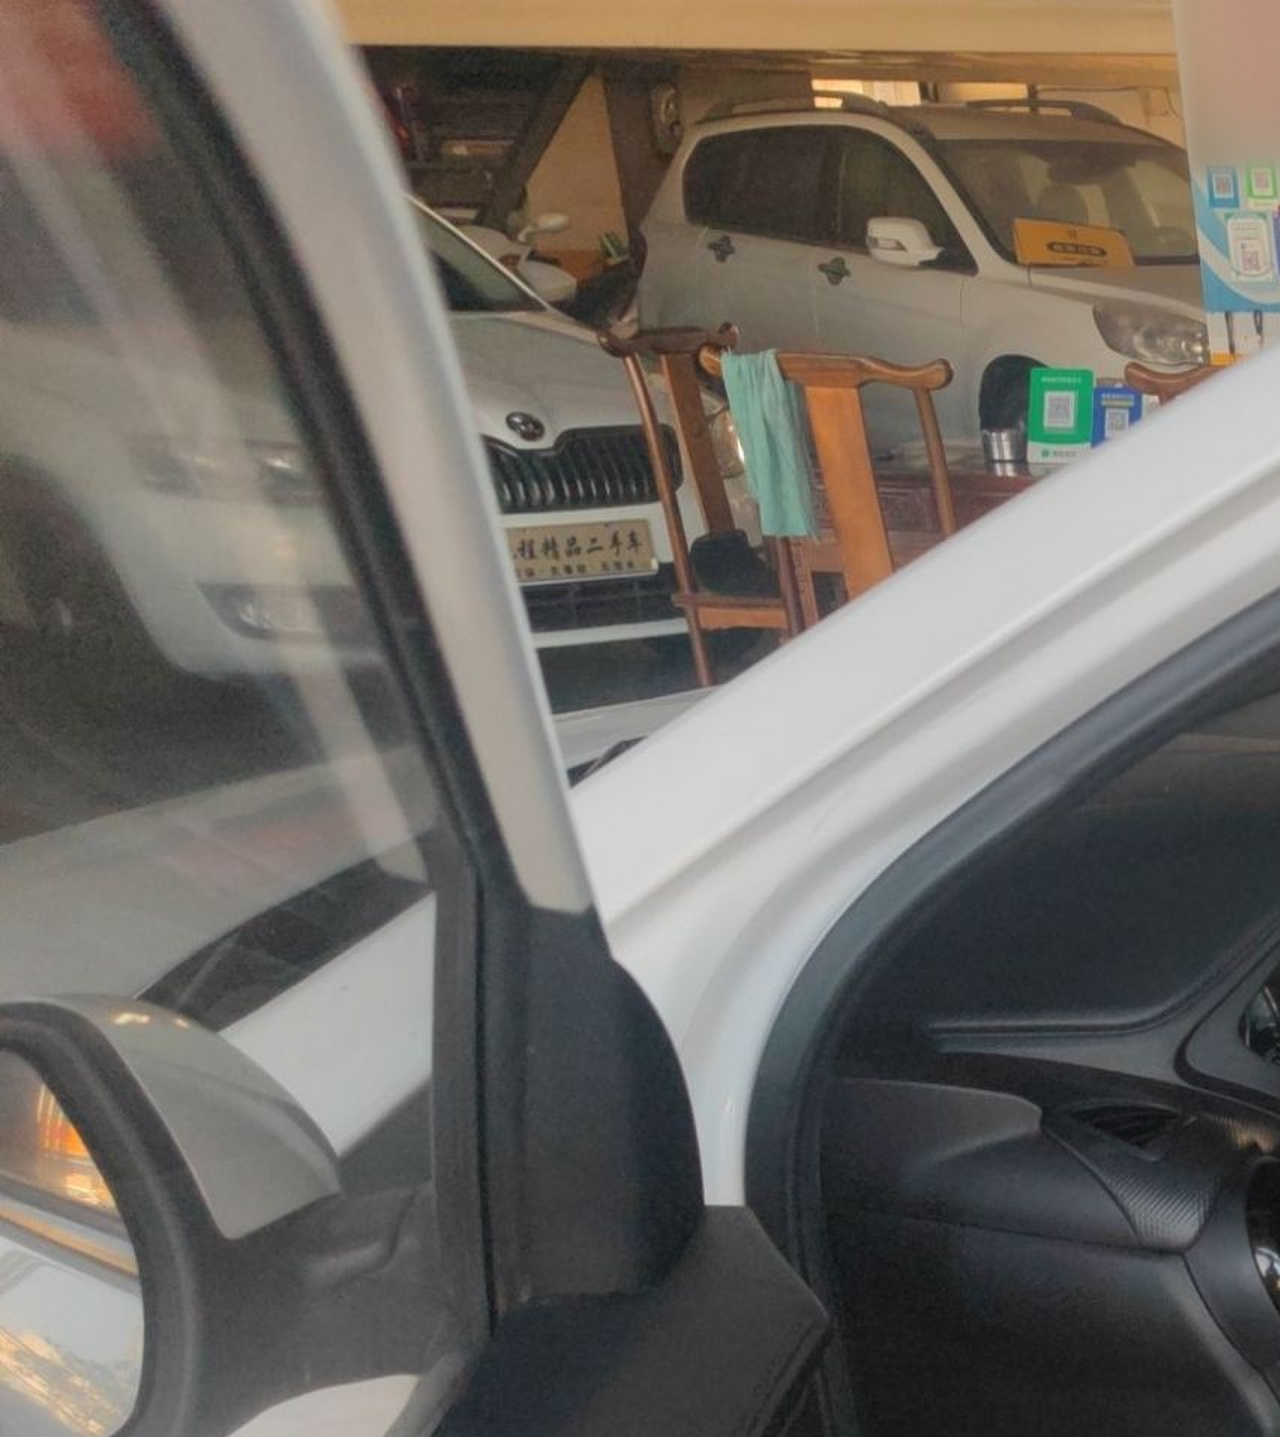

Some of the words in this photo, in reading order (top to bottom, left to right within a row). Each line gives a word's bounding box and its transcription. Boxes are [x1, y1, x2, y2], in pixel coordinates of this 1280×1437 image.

[513, 529, 642, 560] 程精品二手车
